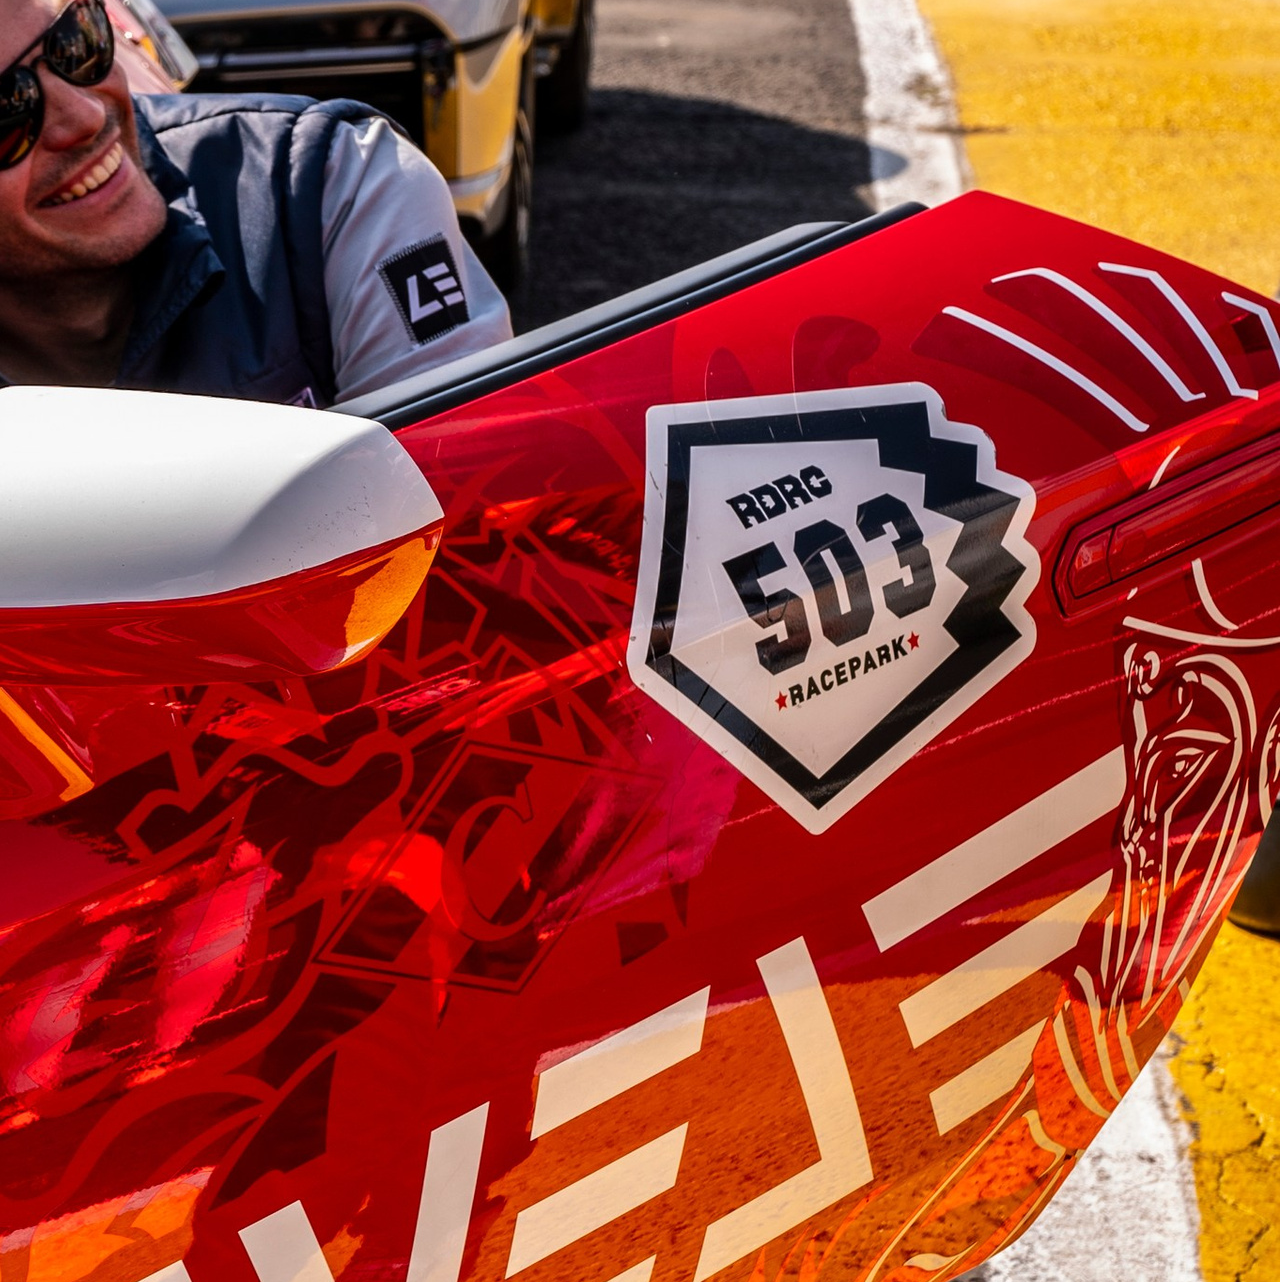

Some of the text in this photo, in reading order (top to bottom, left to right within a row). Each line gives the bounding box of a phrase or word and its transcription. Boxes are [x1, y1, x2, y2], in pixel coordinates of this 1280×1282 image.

[725, 465, 832, 529] RDRC
[722, 493, 936, 675] 503
[788, 634, 908, 706] RACEPARK
